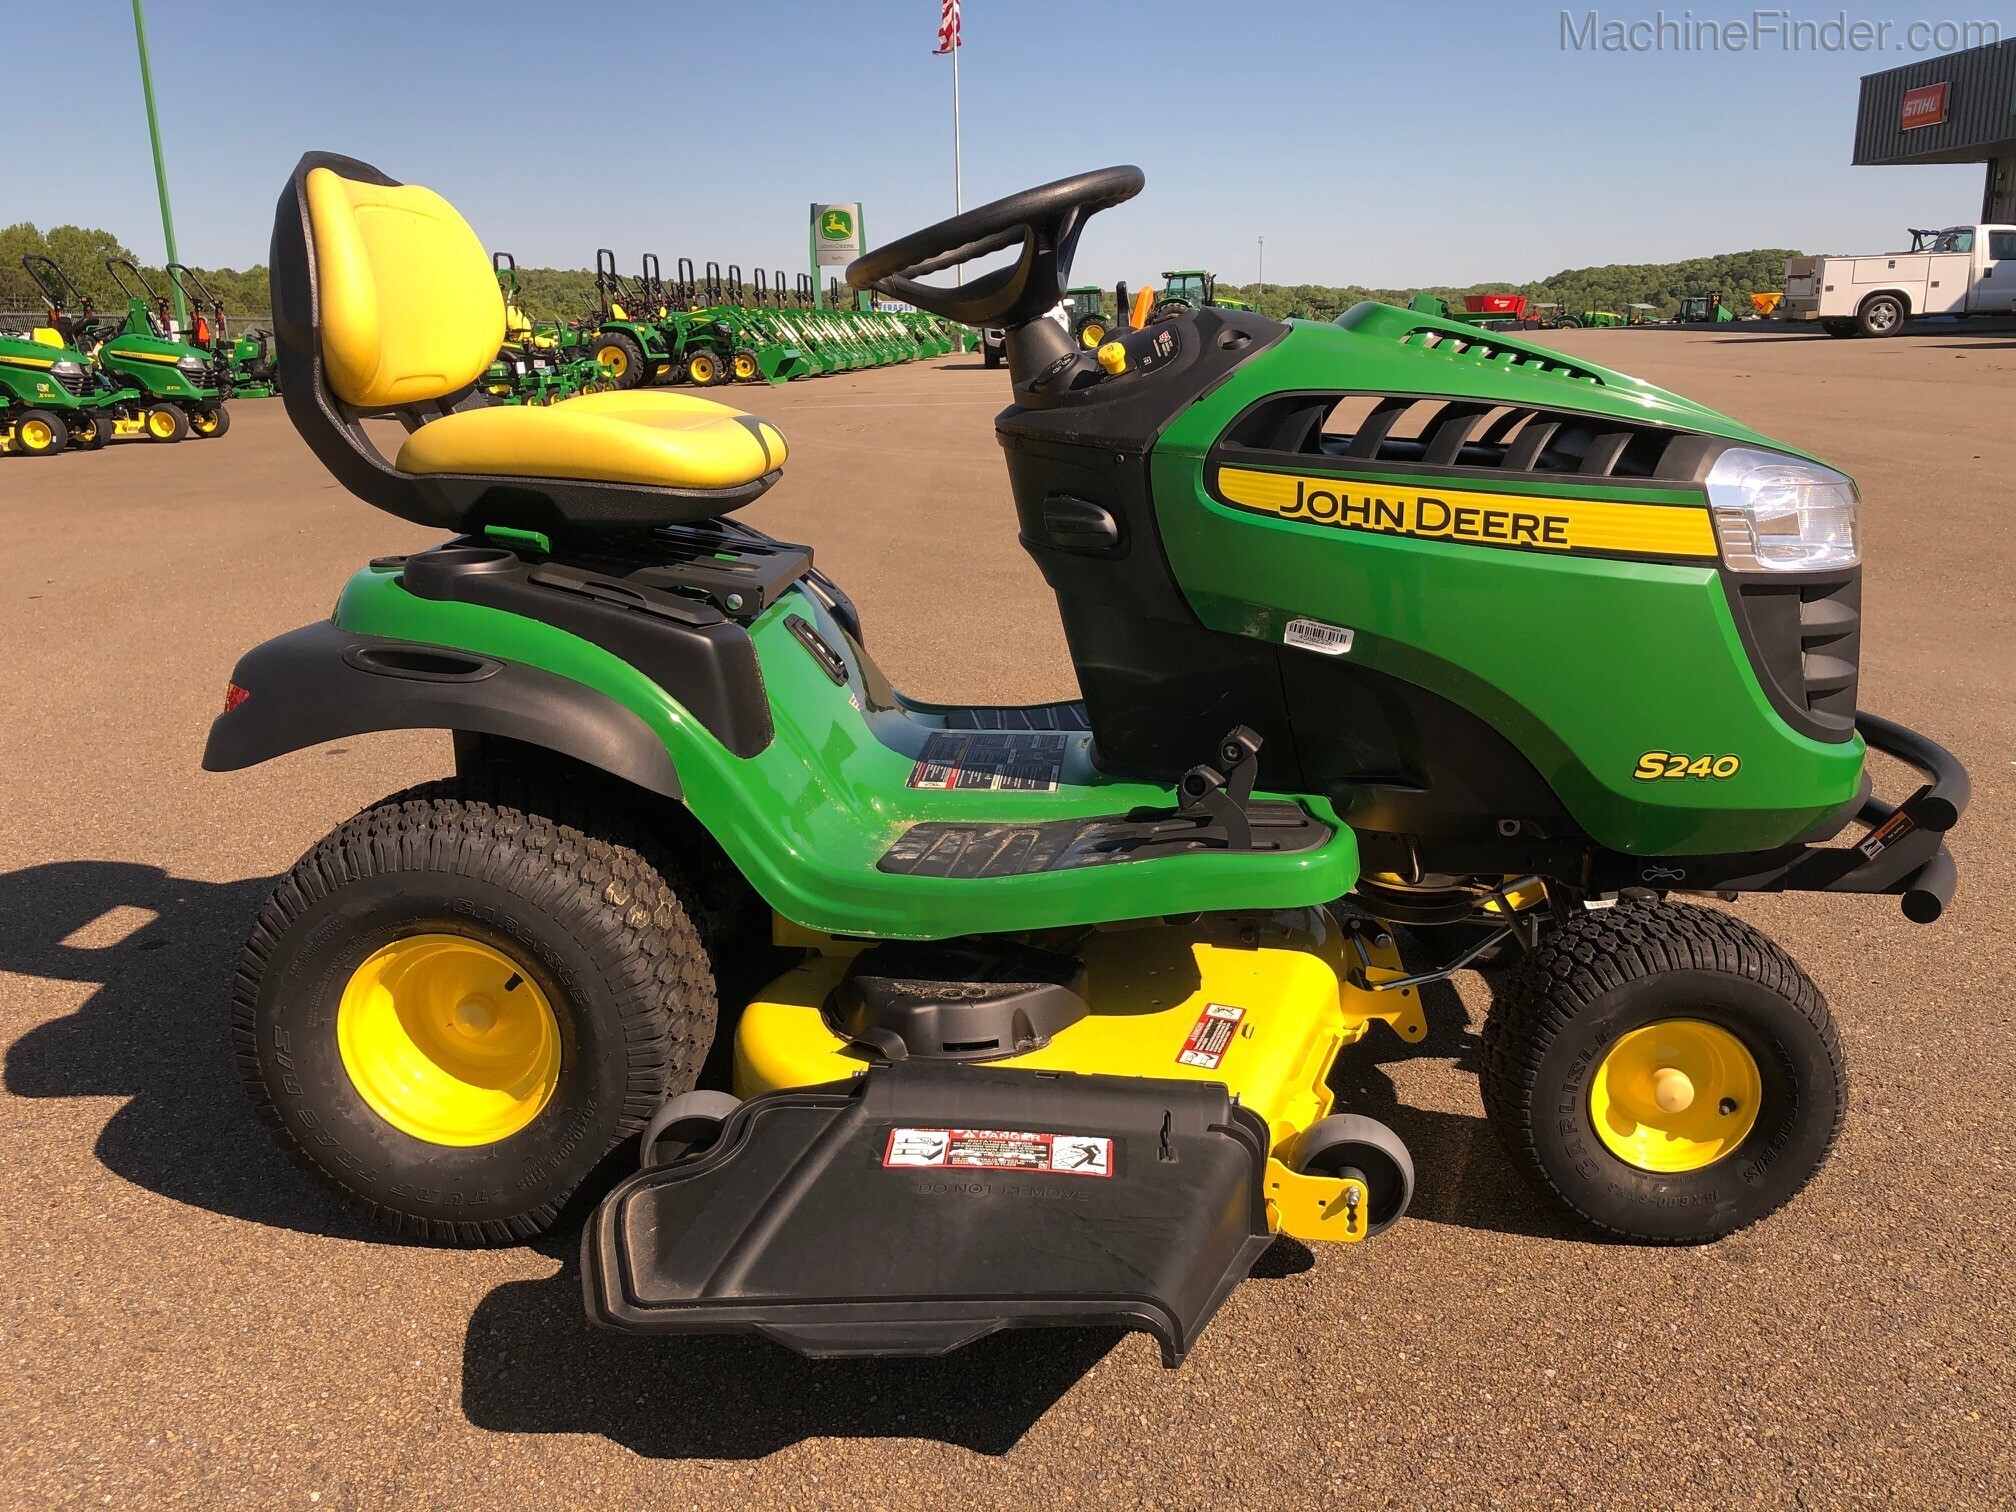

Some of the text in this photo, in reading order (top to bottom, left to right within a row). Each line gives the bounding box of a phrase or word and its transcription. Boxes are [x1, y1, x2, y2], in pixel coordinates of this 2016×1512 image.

[1903, 96, 1937, 117] STIHL
[1279, 480, 1571, 545] JOHN DEERE
[1633, 750, 1741, 780] S240
[917, 1183, 1089, 1202] DO NOT REMOVE
